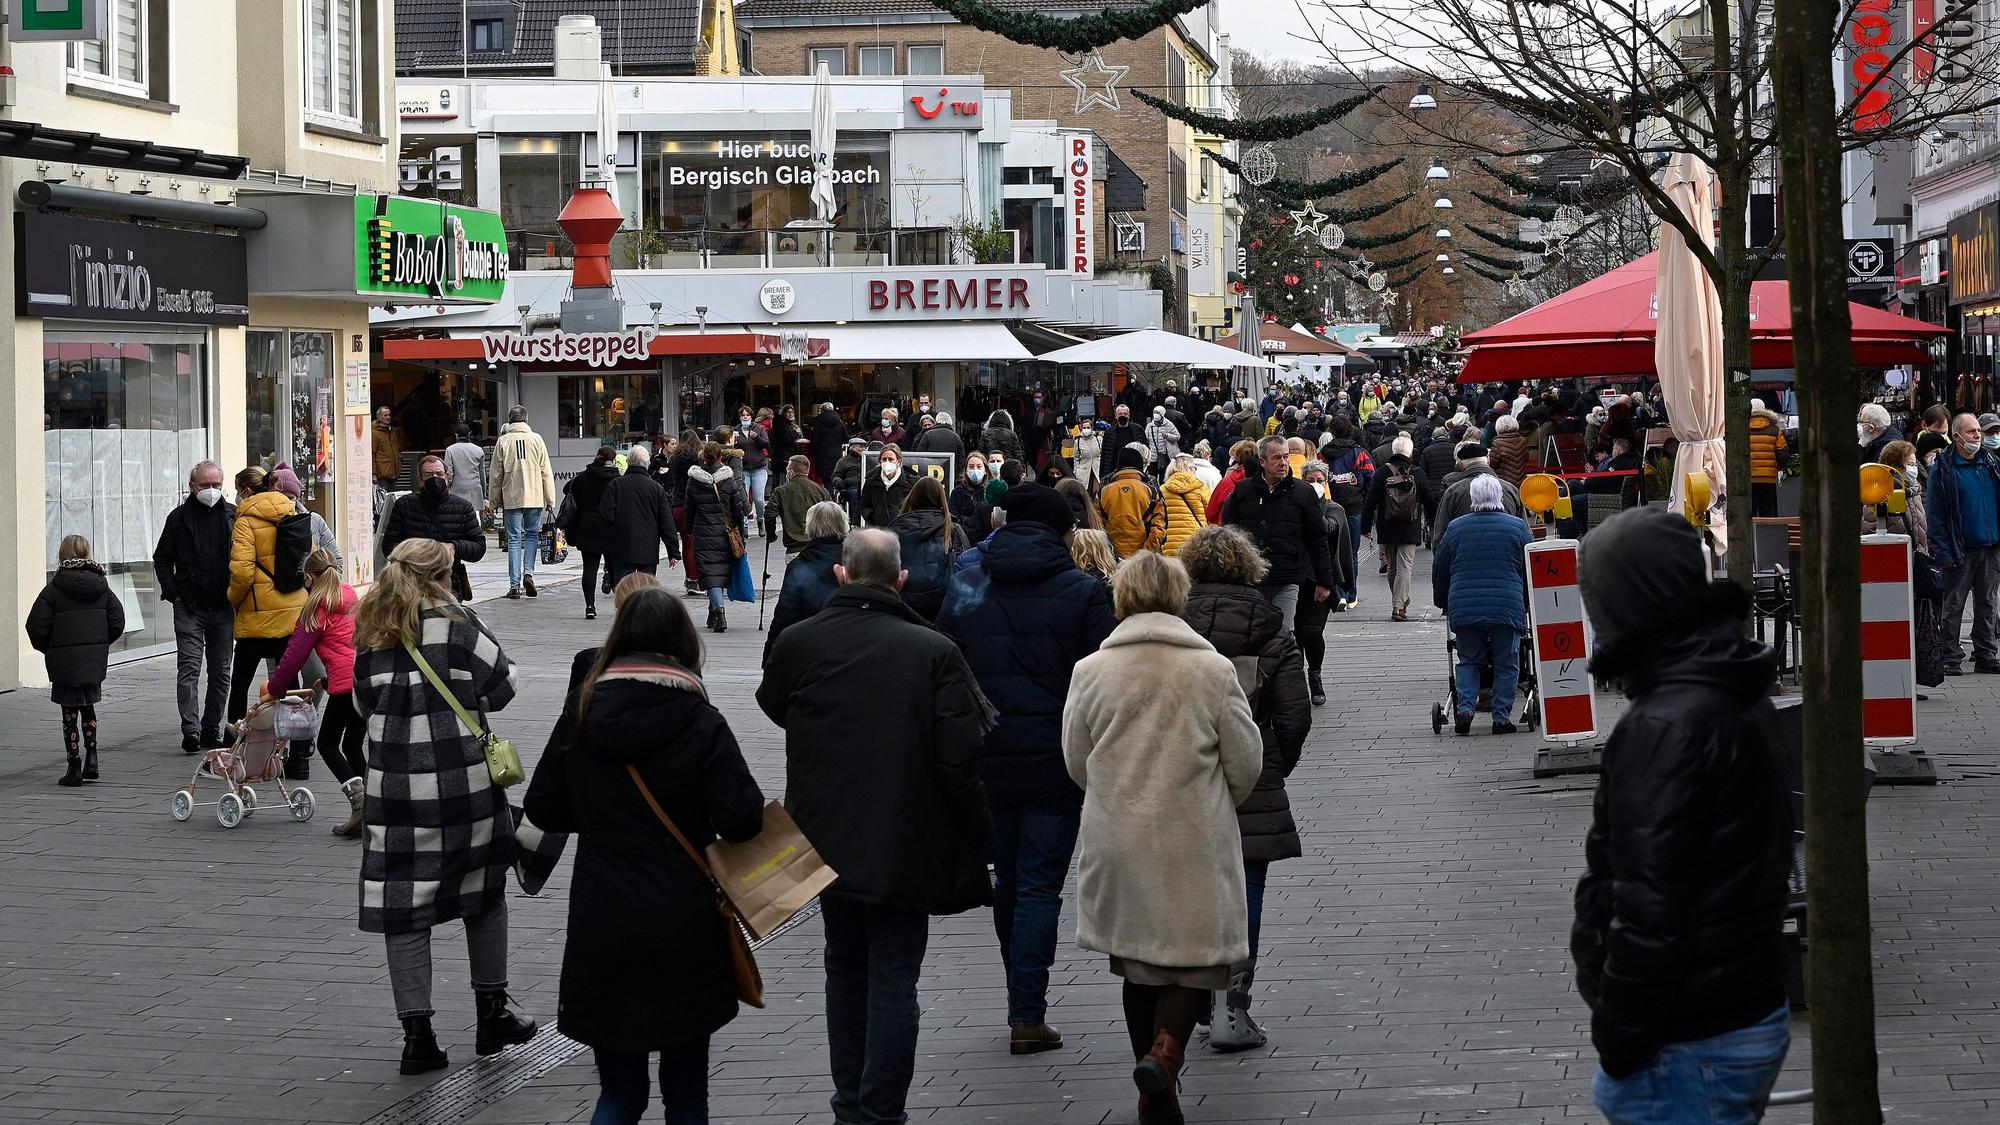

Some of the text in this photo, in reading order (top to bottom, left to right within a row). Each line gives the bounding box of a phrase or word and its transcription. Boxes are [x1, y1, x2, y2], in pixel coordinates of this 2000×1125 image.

[1853, 0, 1892, 133] WOO
[951, 102, 978, 115] TUI
[718, 140, 811, 158] Hier buc
[669, 166, 768, 190] Bergisch
[1071, 139, 1088, 273] RÖSELER
[1192, 228, 1203, 269] WILMS
[1238, 247, 1247, 279] KIND
[395, 231, 509, 299] BoBoQ Bubble Tea
[764, 286, 791, 295] BREMER
[868, 278, 1031, 310] BREMER
[485, 331, 646, 362] Wurstseppel
